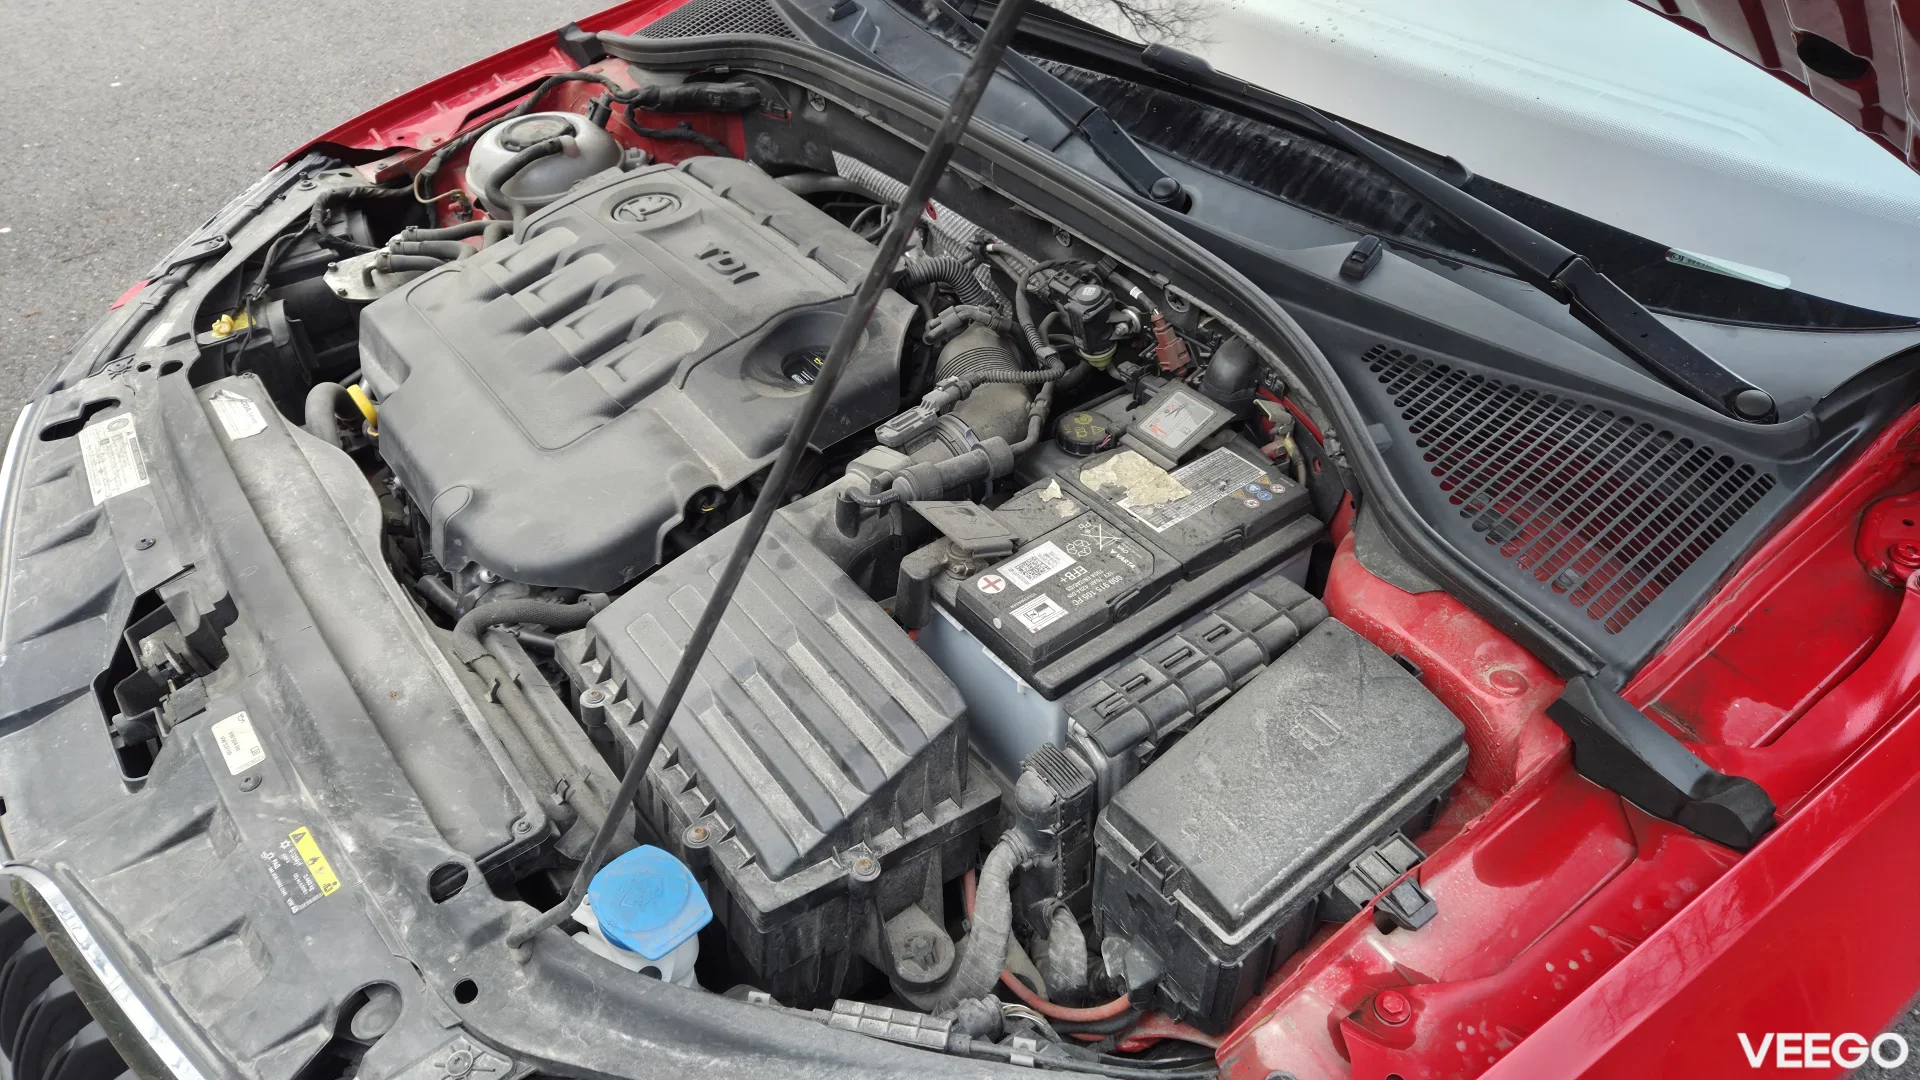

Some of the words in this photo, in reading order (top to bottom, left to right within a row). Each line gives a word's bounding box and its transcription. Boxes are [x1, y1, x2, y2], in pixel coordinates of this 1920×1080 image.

[694, 241, 760, 284] TDI
[1077, 520, 1091, 530] Pb
[1115, 552, 1136, 568] VARTA
[1058, 564, 1087, 584] EFB+
[1094, 581, 1110, 592] 915
[1081, 589, 1096, 600] 105
[1070, 596, 1083, 606] FC
